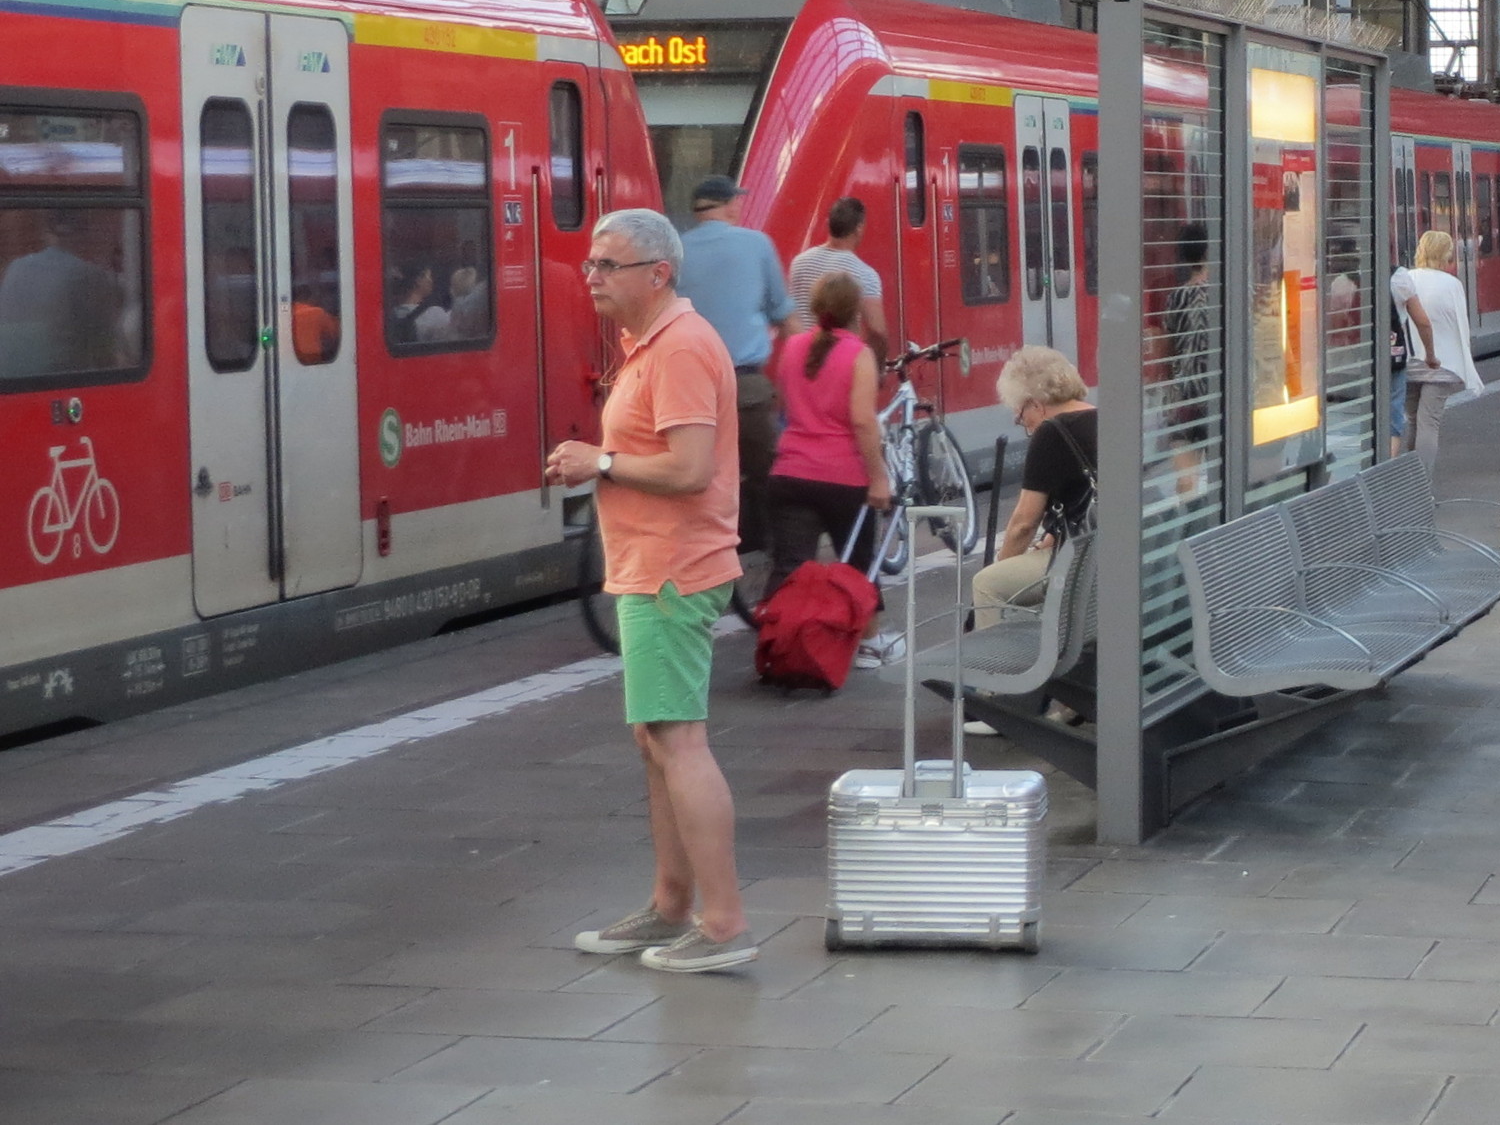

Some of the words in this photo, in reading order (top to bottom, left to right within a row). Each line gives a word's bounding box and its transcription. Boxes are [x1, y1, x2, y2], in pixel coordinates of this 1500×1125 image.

[669, 37, 706, 64] Ost
[504, 128, 516, 190] 1
[383, 414, 398, 462] S
[405, 421, 433, 447] Bahn
[435, 413, 491, 444] Rhein-Main
[73, 533, 81, 559] 8
